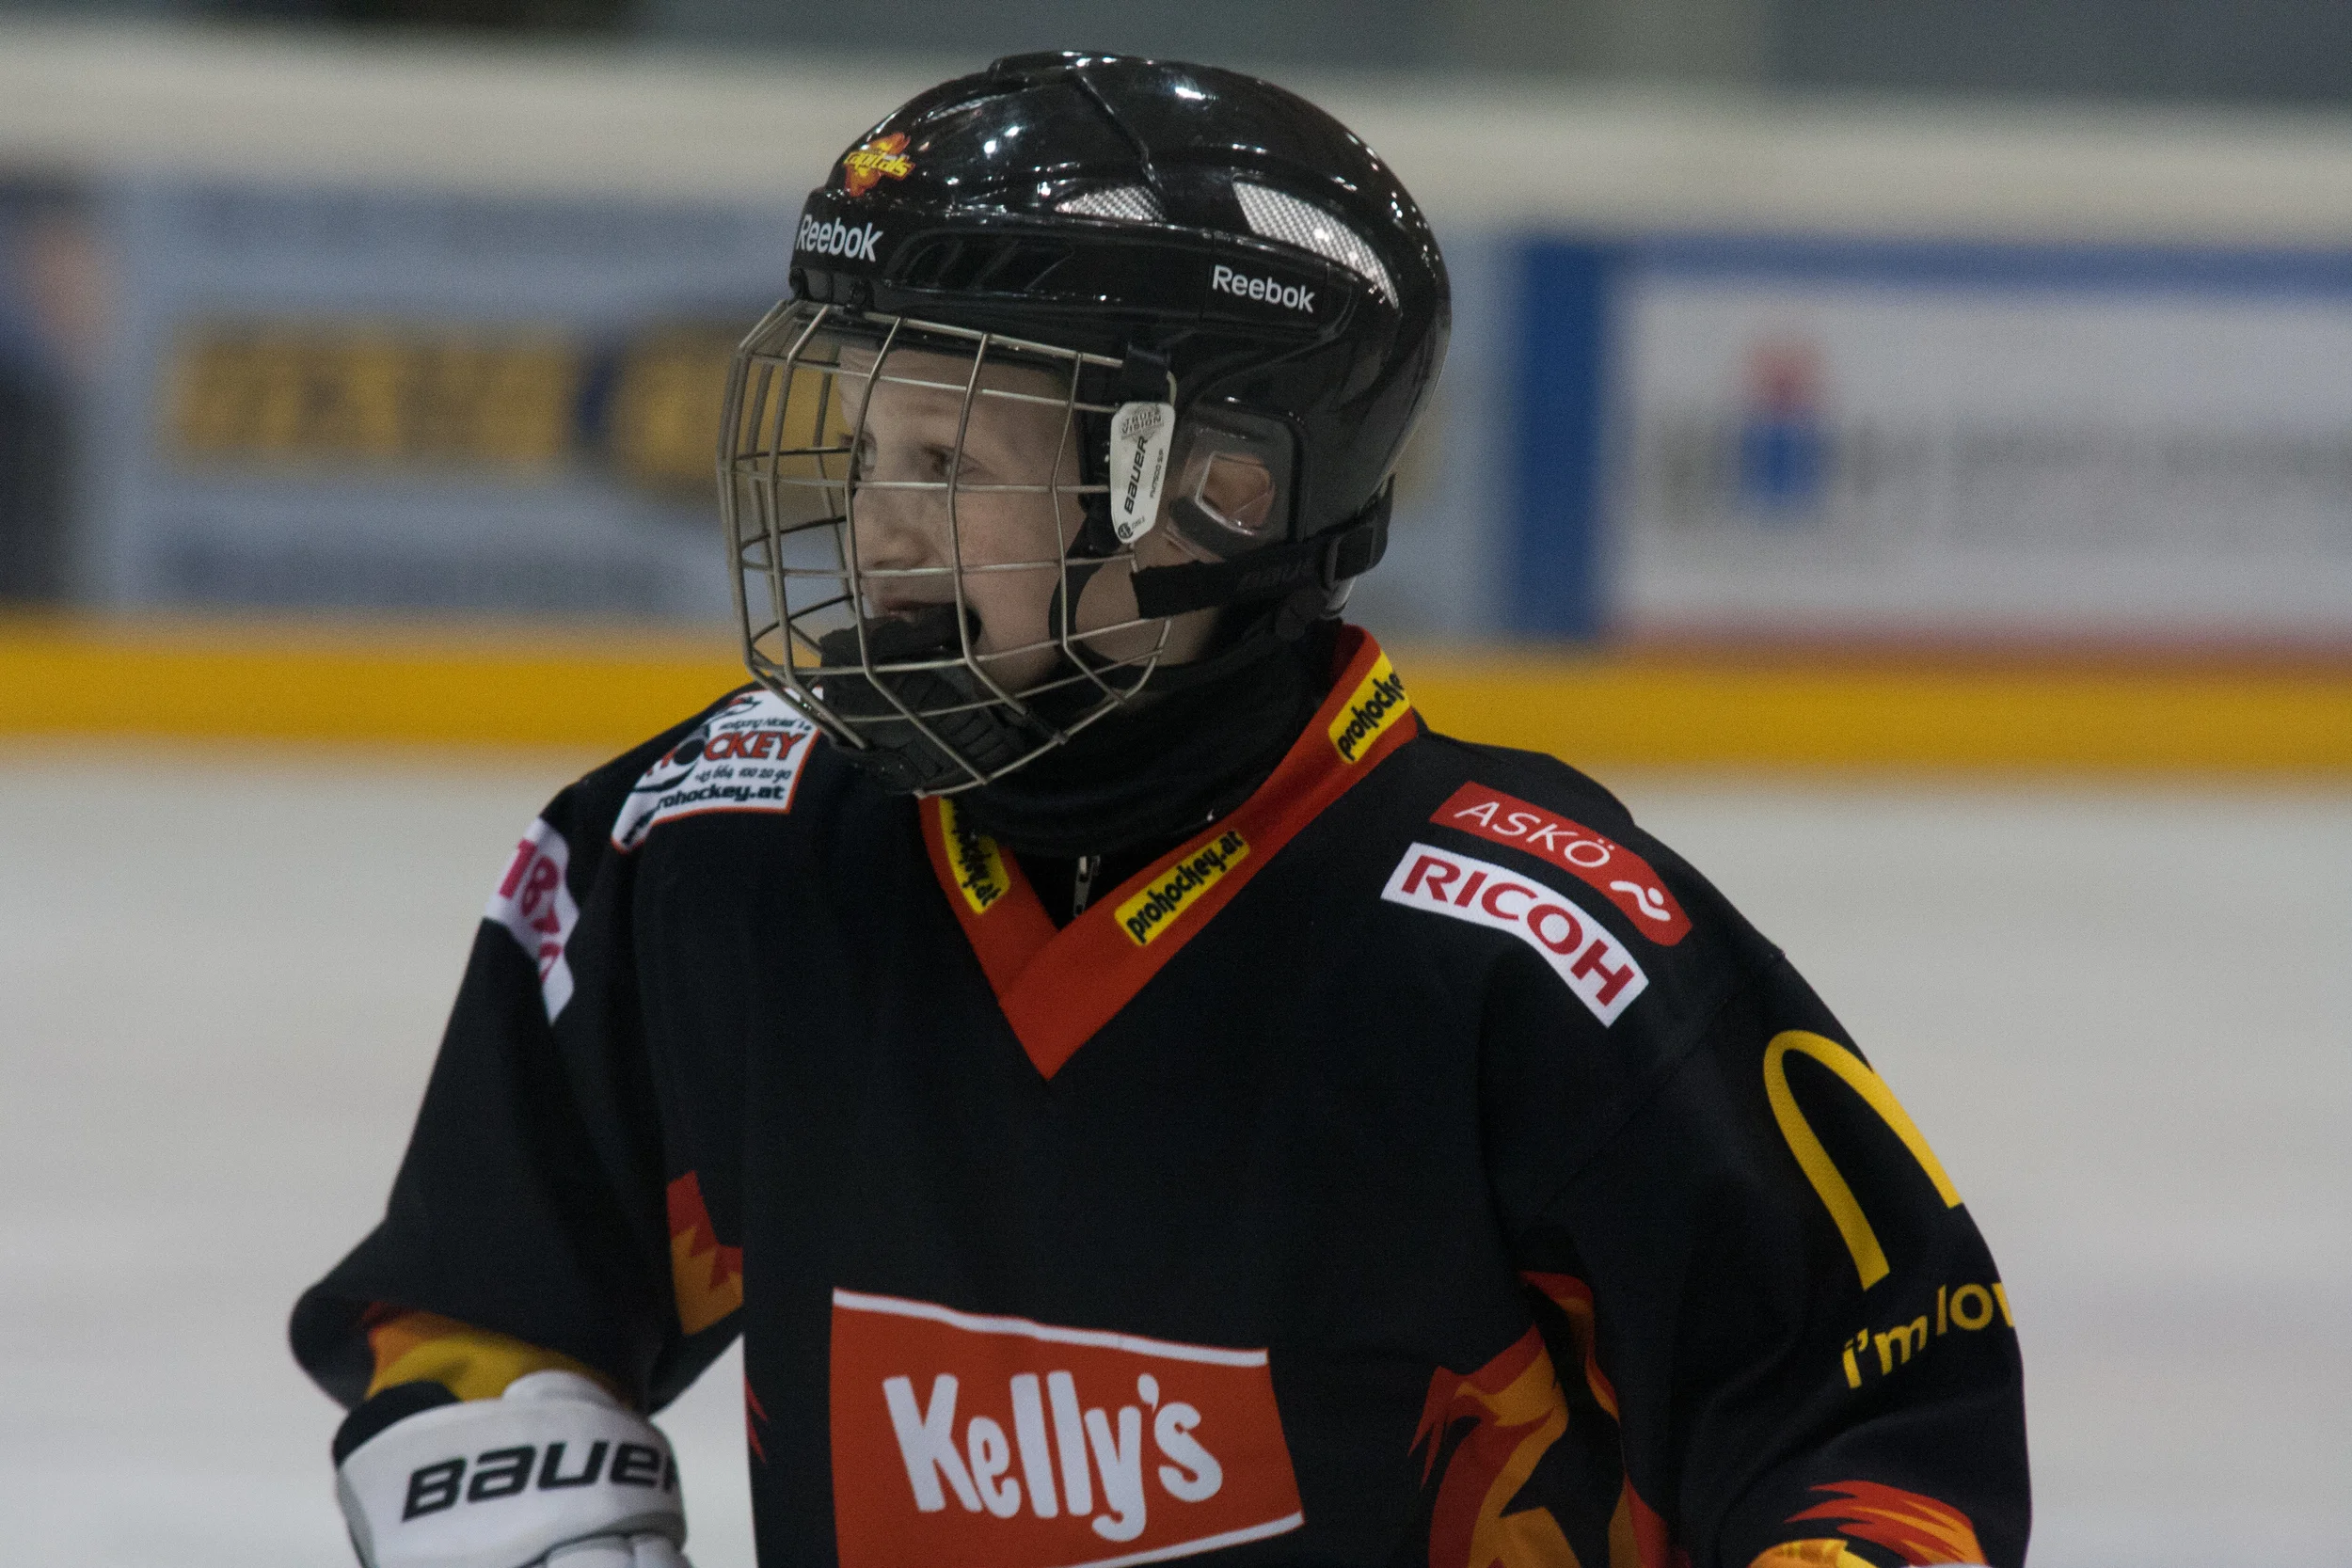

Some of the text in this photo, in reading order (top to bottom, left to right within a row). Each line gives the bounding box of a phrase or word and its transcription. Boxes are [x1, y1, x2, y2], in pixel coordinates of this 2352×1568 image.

[796, 214, 883, 262] Reebok
[1212, 264, 1315, 313] Reebok
[1124, 436, 1149, 515] BAUER
[1454, 800, 1614, 868] ASKÖ
[1126, 831, 1244, 944] prohockey.at
[1401, 854, 1635, 1007] RICOH
[1842, 1315, 1928, 1389] i'm
[883, 1371, 1223, 1543] Kelly's
